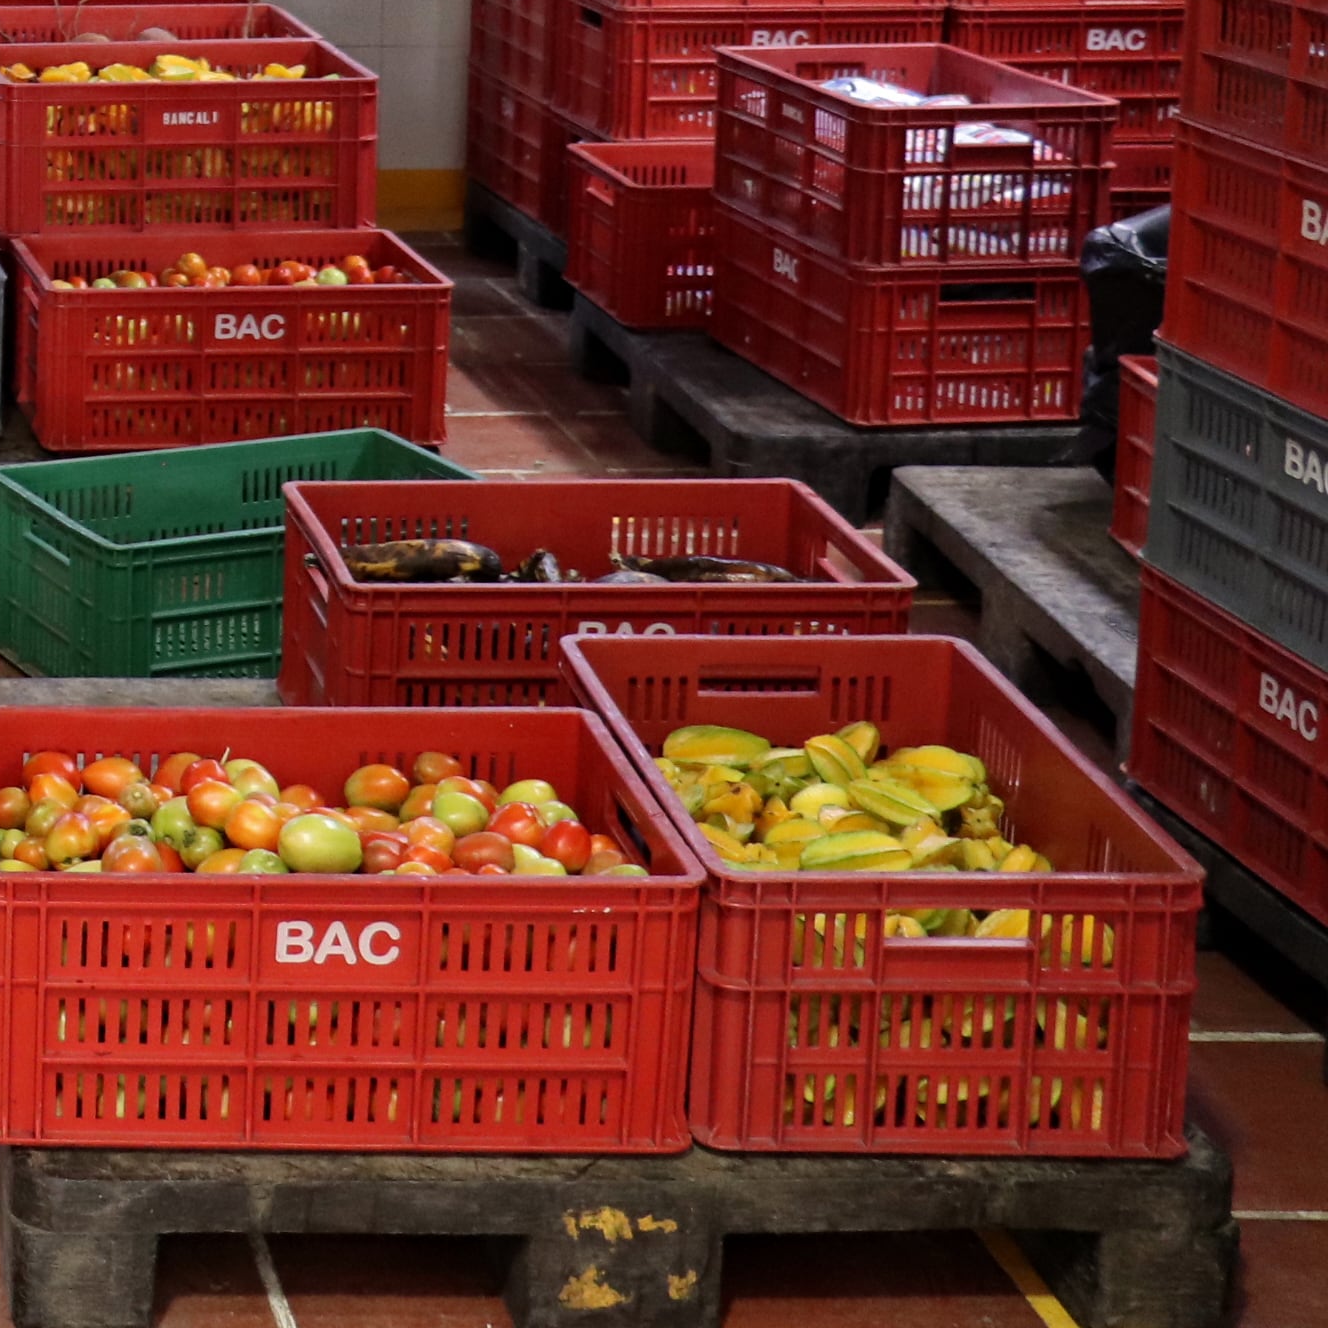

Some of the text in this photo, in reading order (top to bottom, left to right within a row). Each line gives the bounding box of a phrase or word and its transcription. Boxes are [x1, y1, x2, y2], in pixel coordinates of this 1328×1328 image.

[1086, 29, 1145, 52] BAC
[215, 314, 285, 340] BAC
[1284, 438, 1328, 494] BA
[1259, 672, 1318, 742] BAC
[275, 920, 400, 965] BAC
